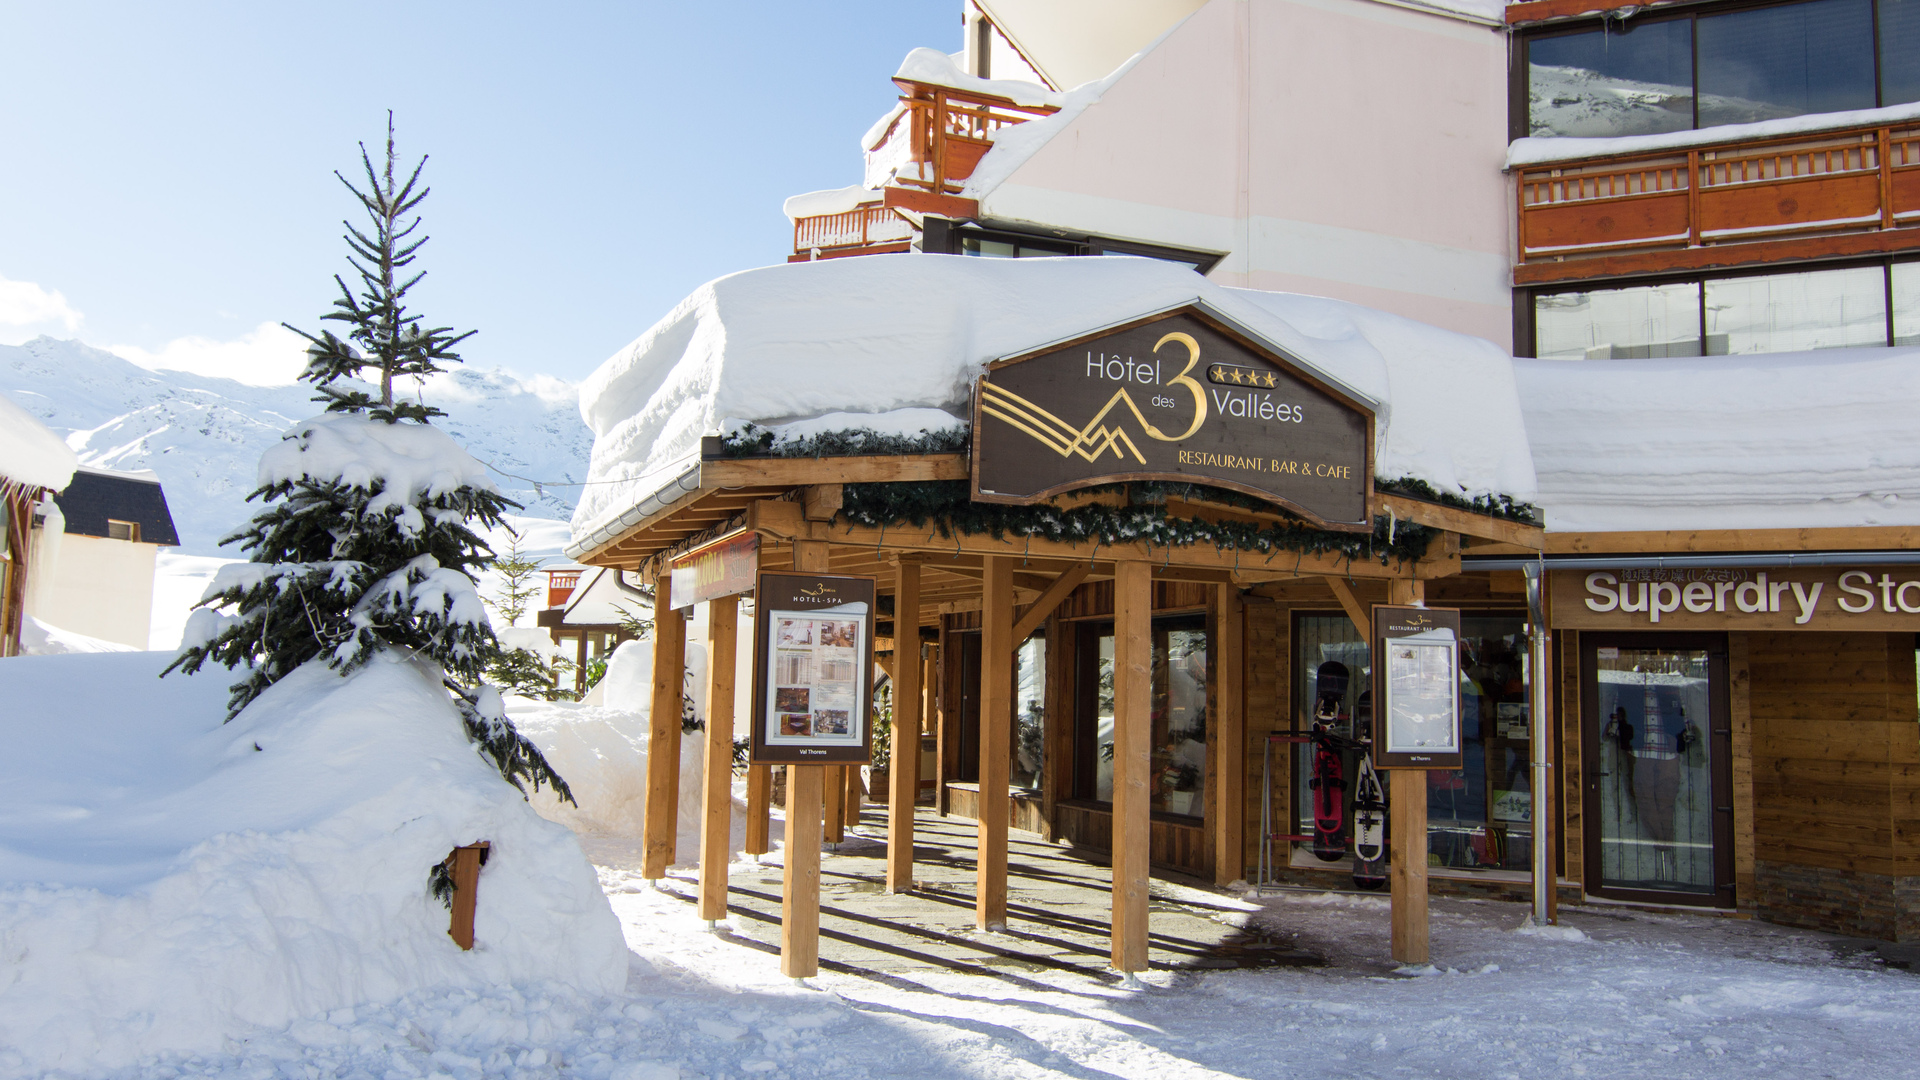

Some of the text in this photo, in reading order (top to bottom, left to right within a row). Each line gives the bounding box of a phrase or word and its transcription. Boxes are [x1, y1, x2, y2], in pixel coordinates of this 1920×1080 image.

[1086, 331, 1303, 442] Hôtel des 3 Vallées
[1178, 450, 1351, 480] RESTAURANT, BAR & CAFE
[1620, 568, 1749, 583] 極度乾燥(しなさい)
[1584, 570, 1920, 624] Superdry Sto
